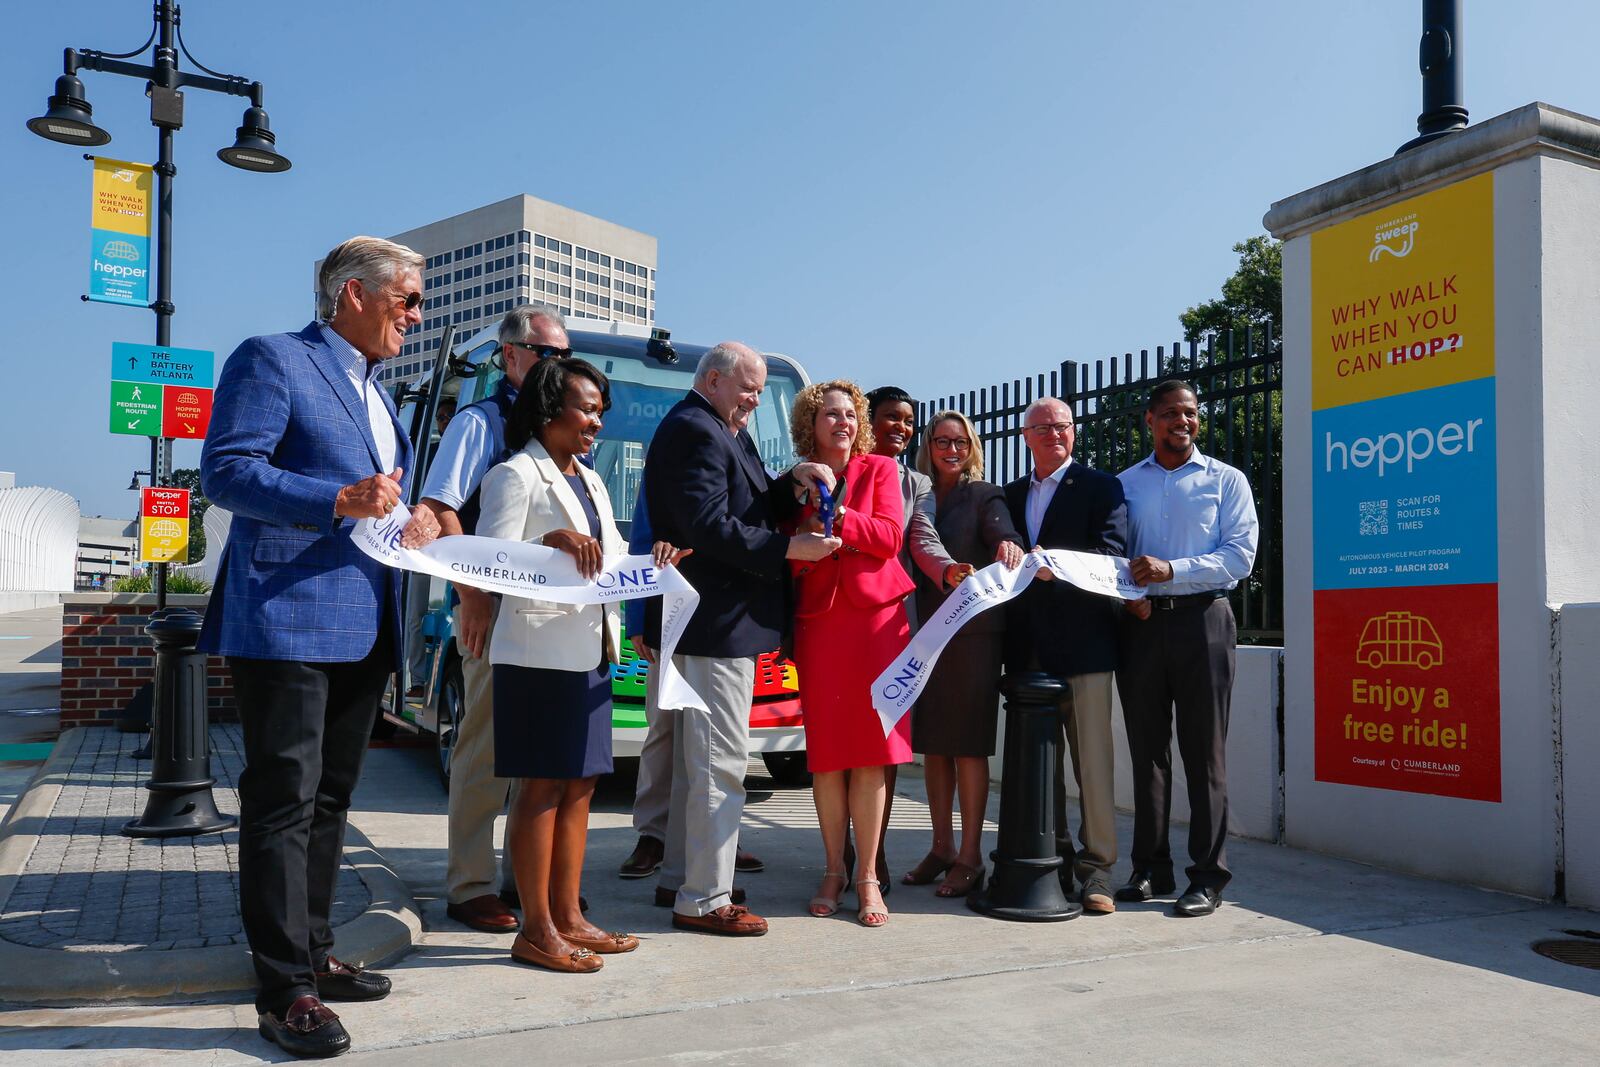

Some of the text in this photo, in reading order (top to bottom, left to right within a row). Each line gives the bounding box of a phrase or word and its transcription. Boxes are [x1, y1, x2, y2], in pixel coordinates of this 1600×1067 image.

[99, 198, 124, 208] WHEN
[120, 195, 143, 204] WALK
[1374, 220, 1419, 244] sweep
[94, 259, 147, 278] hopper
[1331, 274, 1458, 326] WHY WALK
[1331, 304, 1457, 353] WHEN YOU
[151, 352, 170, 360] THE
[1337, 333, 1460, 378] CAN HOP?
[151, 360, 194, 372] BATTERY
[150, 370, 194, 380] ATLANTA
[116, 401, 157, 410] PEDESTRIAN
[1326, 418, 1483, 477] hopper
[152, 490, 182, 500] hopper
[1396, 494, 1441, 508] SCAN FOR
[152, 506, 180, 514] STOP
[1396, 507, 1440, 518] ROUTES &
[1396, 521, 1424, 530] TIMES
[1339, 548, 1461, 562] AUTONOMOUS VEHICLE PILOT PROGRAM
[451, 562, 547, 585] CUMBERLAND
[1348, 566, 1367, 575] JULY
[1368, 566, 1388, 574] 2023
[1395, 563, 1426, 573] MARCH
[1428, 562, 1449, 571] 2024
[596, 568, 657, 588] ONE
[598, 586, 659, 597] CUMBERLAND
[882, 656, 924, 700] ONE
[896, 664, 928, 708] CUMBERLAND
[1352, 678, 1449, 714] Enjoy a
[1344, 714, 1467, 750] free ride!
[1352, 756, 1461, 772] Courtesy of CUMBERLAND
